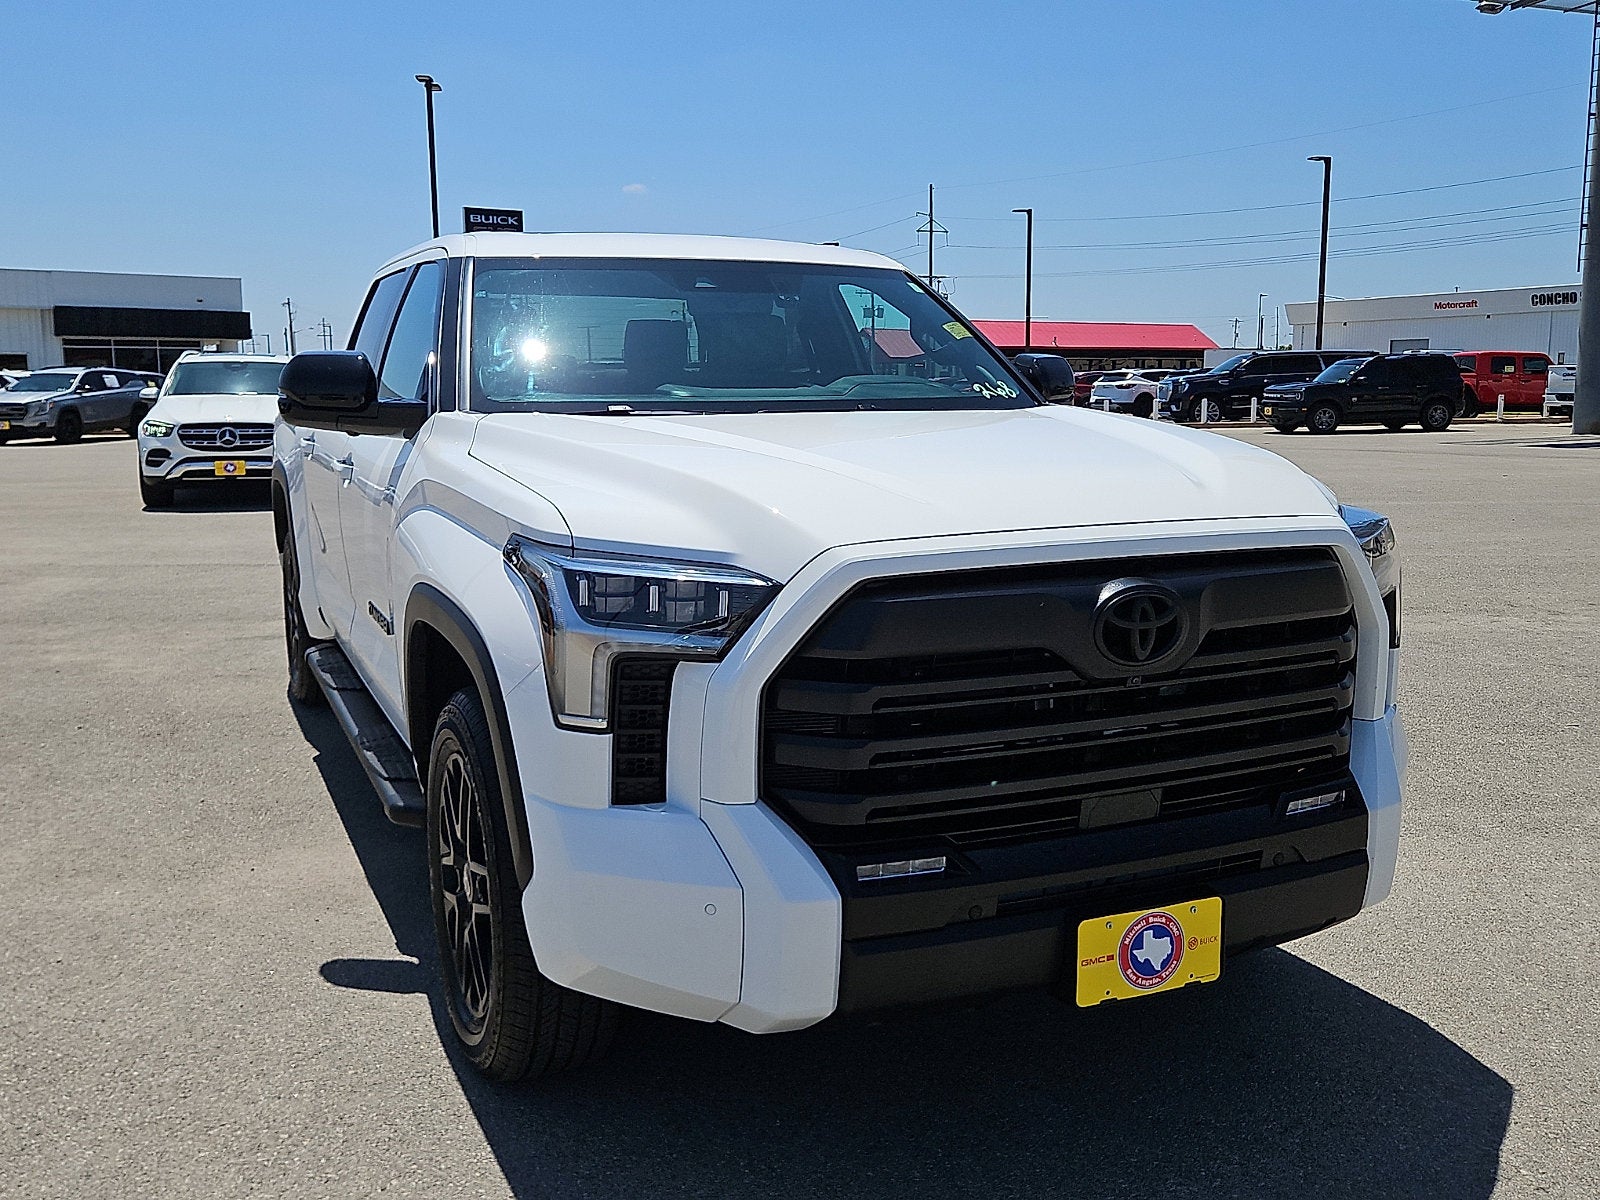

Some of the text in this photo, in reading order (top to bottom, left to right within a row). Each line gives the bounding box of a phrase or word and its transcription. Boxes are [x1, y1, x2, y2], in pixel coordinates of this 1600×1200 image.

[470, 214, 518, 225] BUICK
[1434, 300, 1478, 309] Motorcraft
[1531, 292, 1577, 306] CONCHO
[1124, 920, 1146, 945] Mitchell
[1169, 922, 1180, 936] GMC
[1200, 936, 1218, 945] BUICK
[1081, 955, 1106, 967] GMC
[1125, 968, 1137, 981] San
[1161, 960, 1177, 978] Texas
